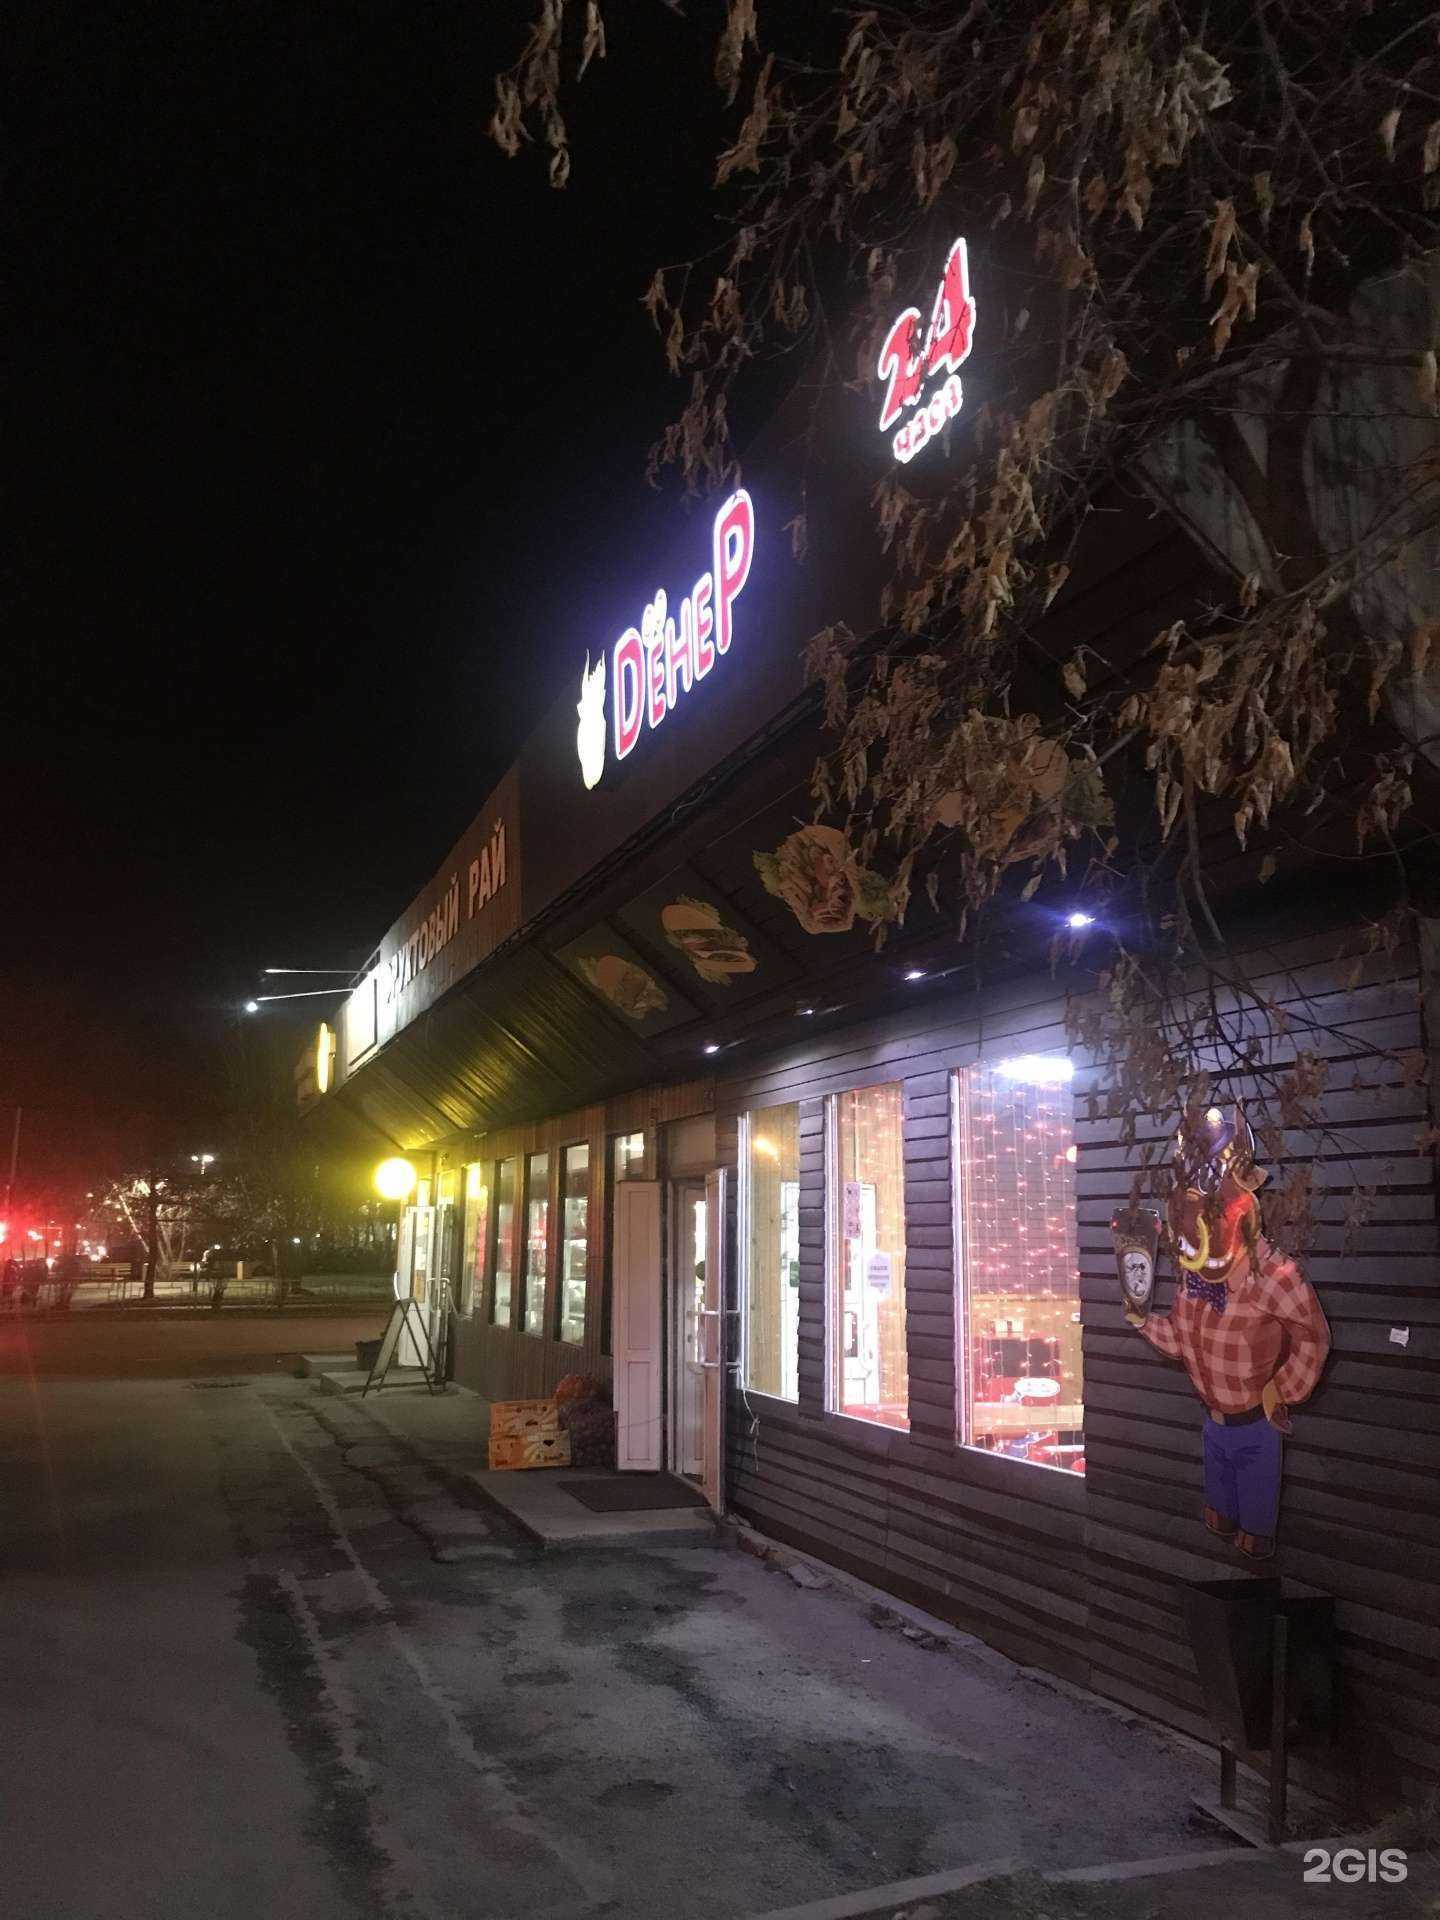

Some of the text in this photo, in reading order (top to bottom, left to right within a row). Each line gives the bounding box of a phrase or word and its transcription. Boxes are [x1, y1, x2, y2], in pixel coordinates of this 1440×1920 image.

[878, 237, 976, 431] 24
[384, 817, 507, 1004] РУКТОВЫЙ РАЙ
